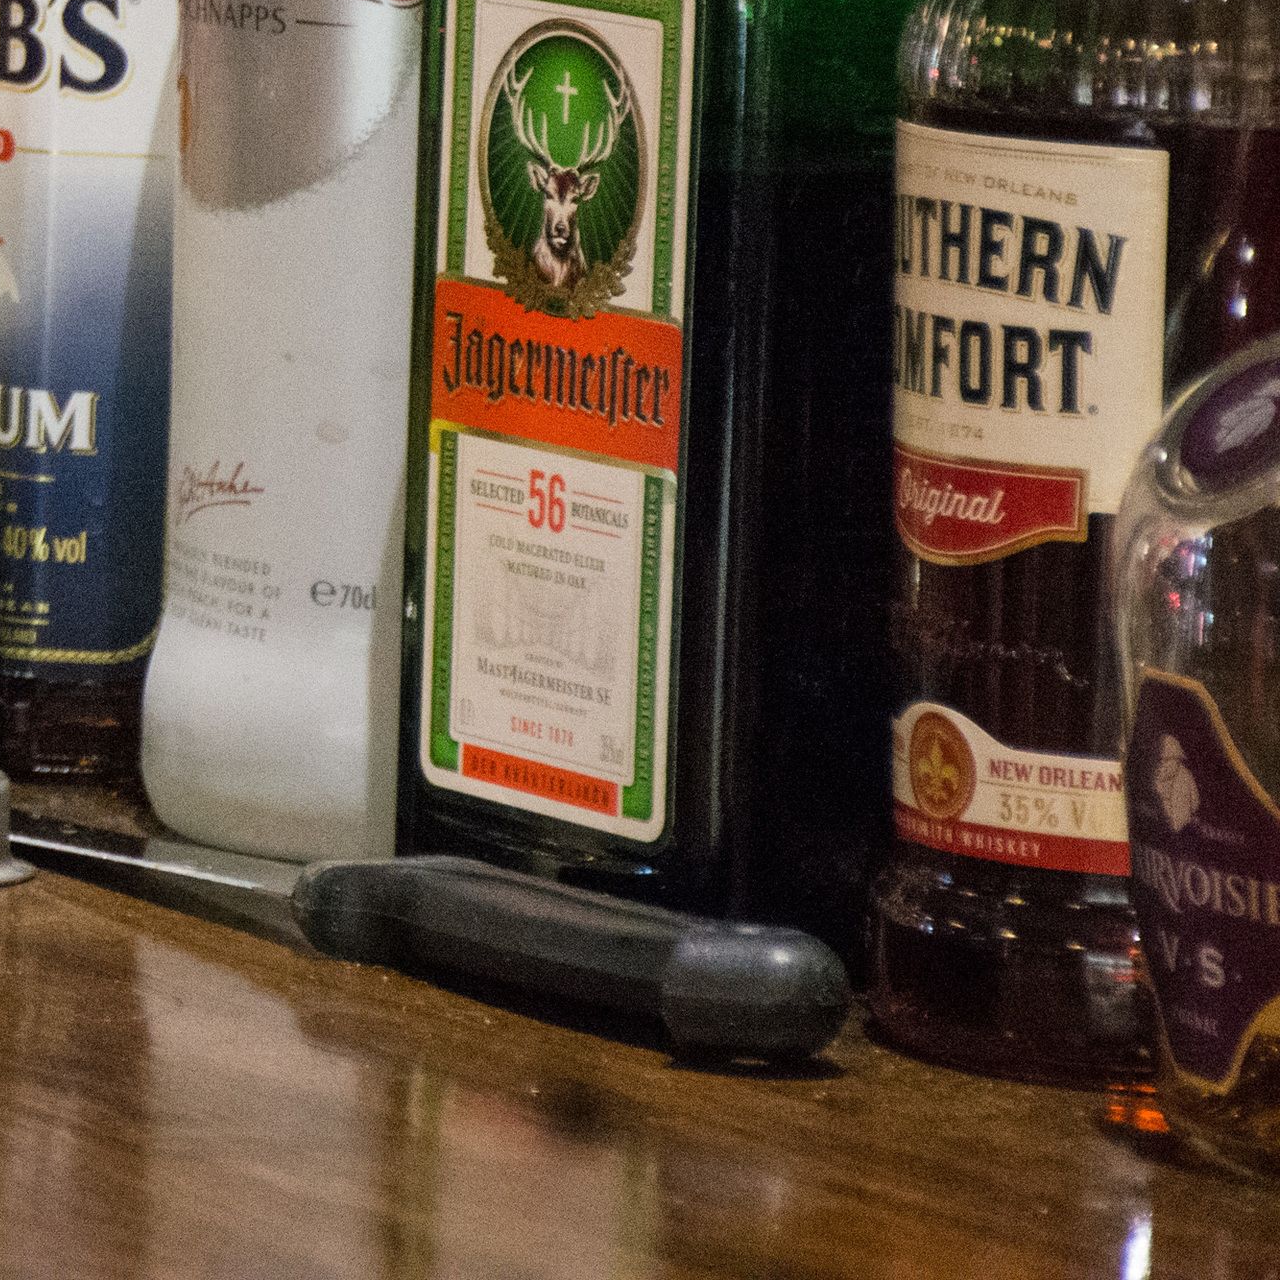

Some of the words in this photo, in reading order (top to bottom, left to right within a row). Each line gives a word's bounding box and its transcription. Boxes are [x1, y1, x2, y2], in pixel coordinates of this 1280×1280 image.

[981, 174, 1079, 207] ORLEANS
[470, 476, 525, 506] SELECTED
[528, 468, 566, 534] 56
[570, 502, 629, 530] BOTANICALS
[51, 530, 88, 565] vol
[988, 758, 1034, 783] NEW
[998, 791, 1060, 830] 35%
[961, 830, 1042, 860] WHISKEY
